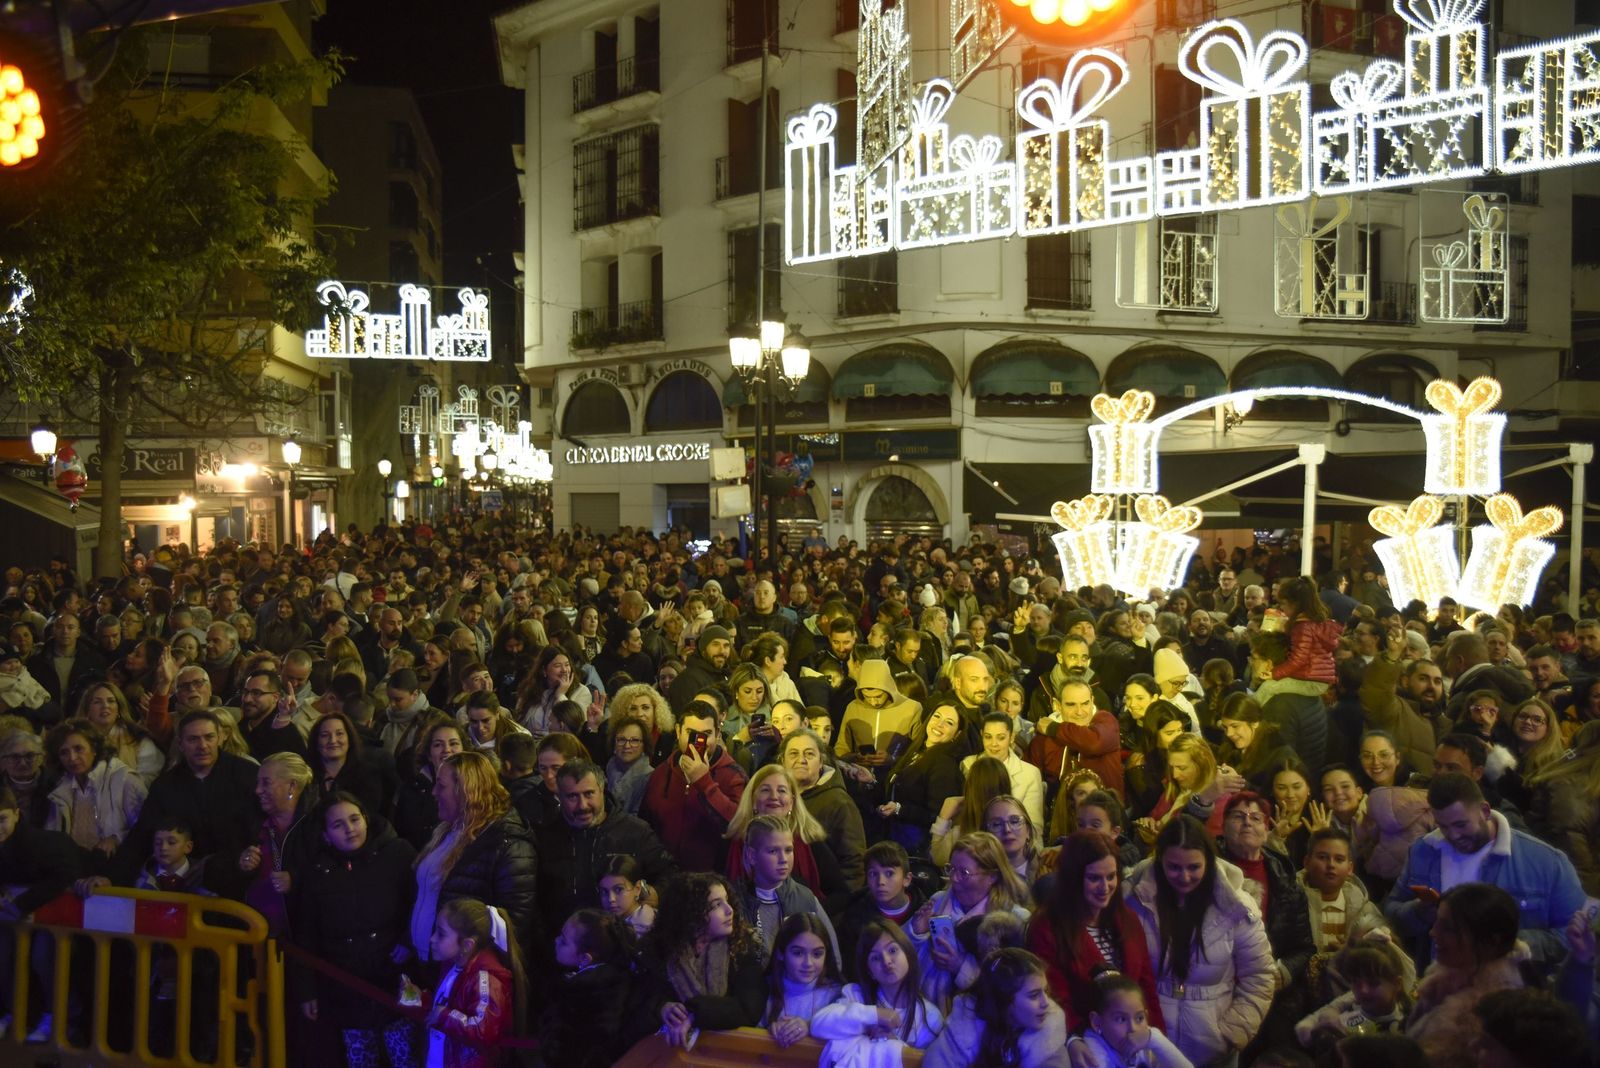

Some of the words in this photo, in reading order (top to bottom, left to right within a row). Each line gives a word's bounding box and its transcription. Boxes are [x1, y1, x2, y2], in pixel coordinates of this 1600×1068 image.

[653, 359, 712, 383] ABOGADOS
[135, 451, 184, 475] Real
[611, 445, 655, 463] DENTAL
[656, 443, 710, 461] CROOKE
